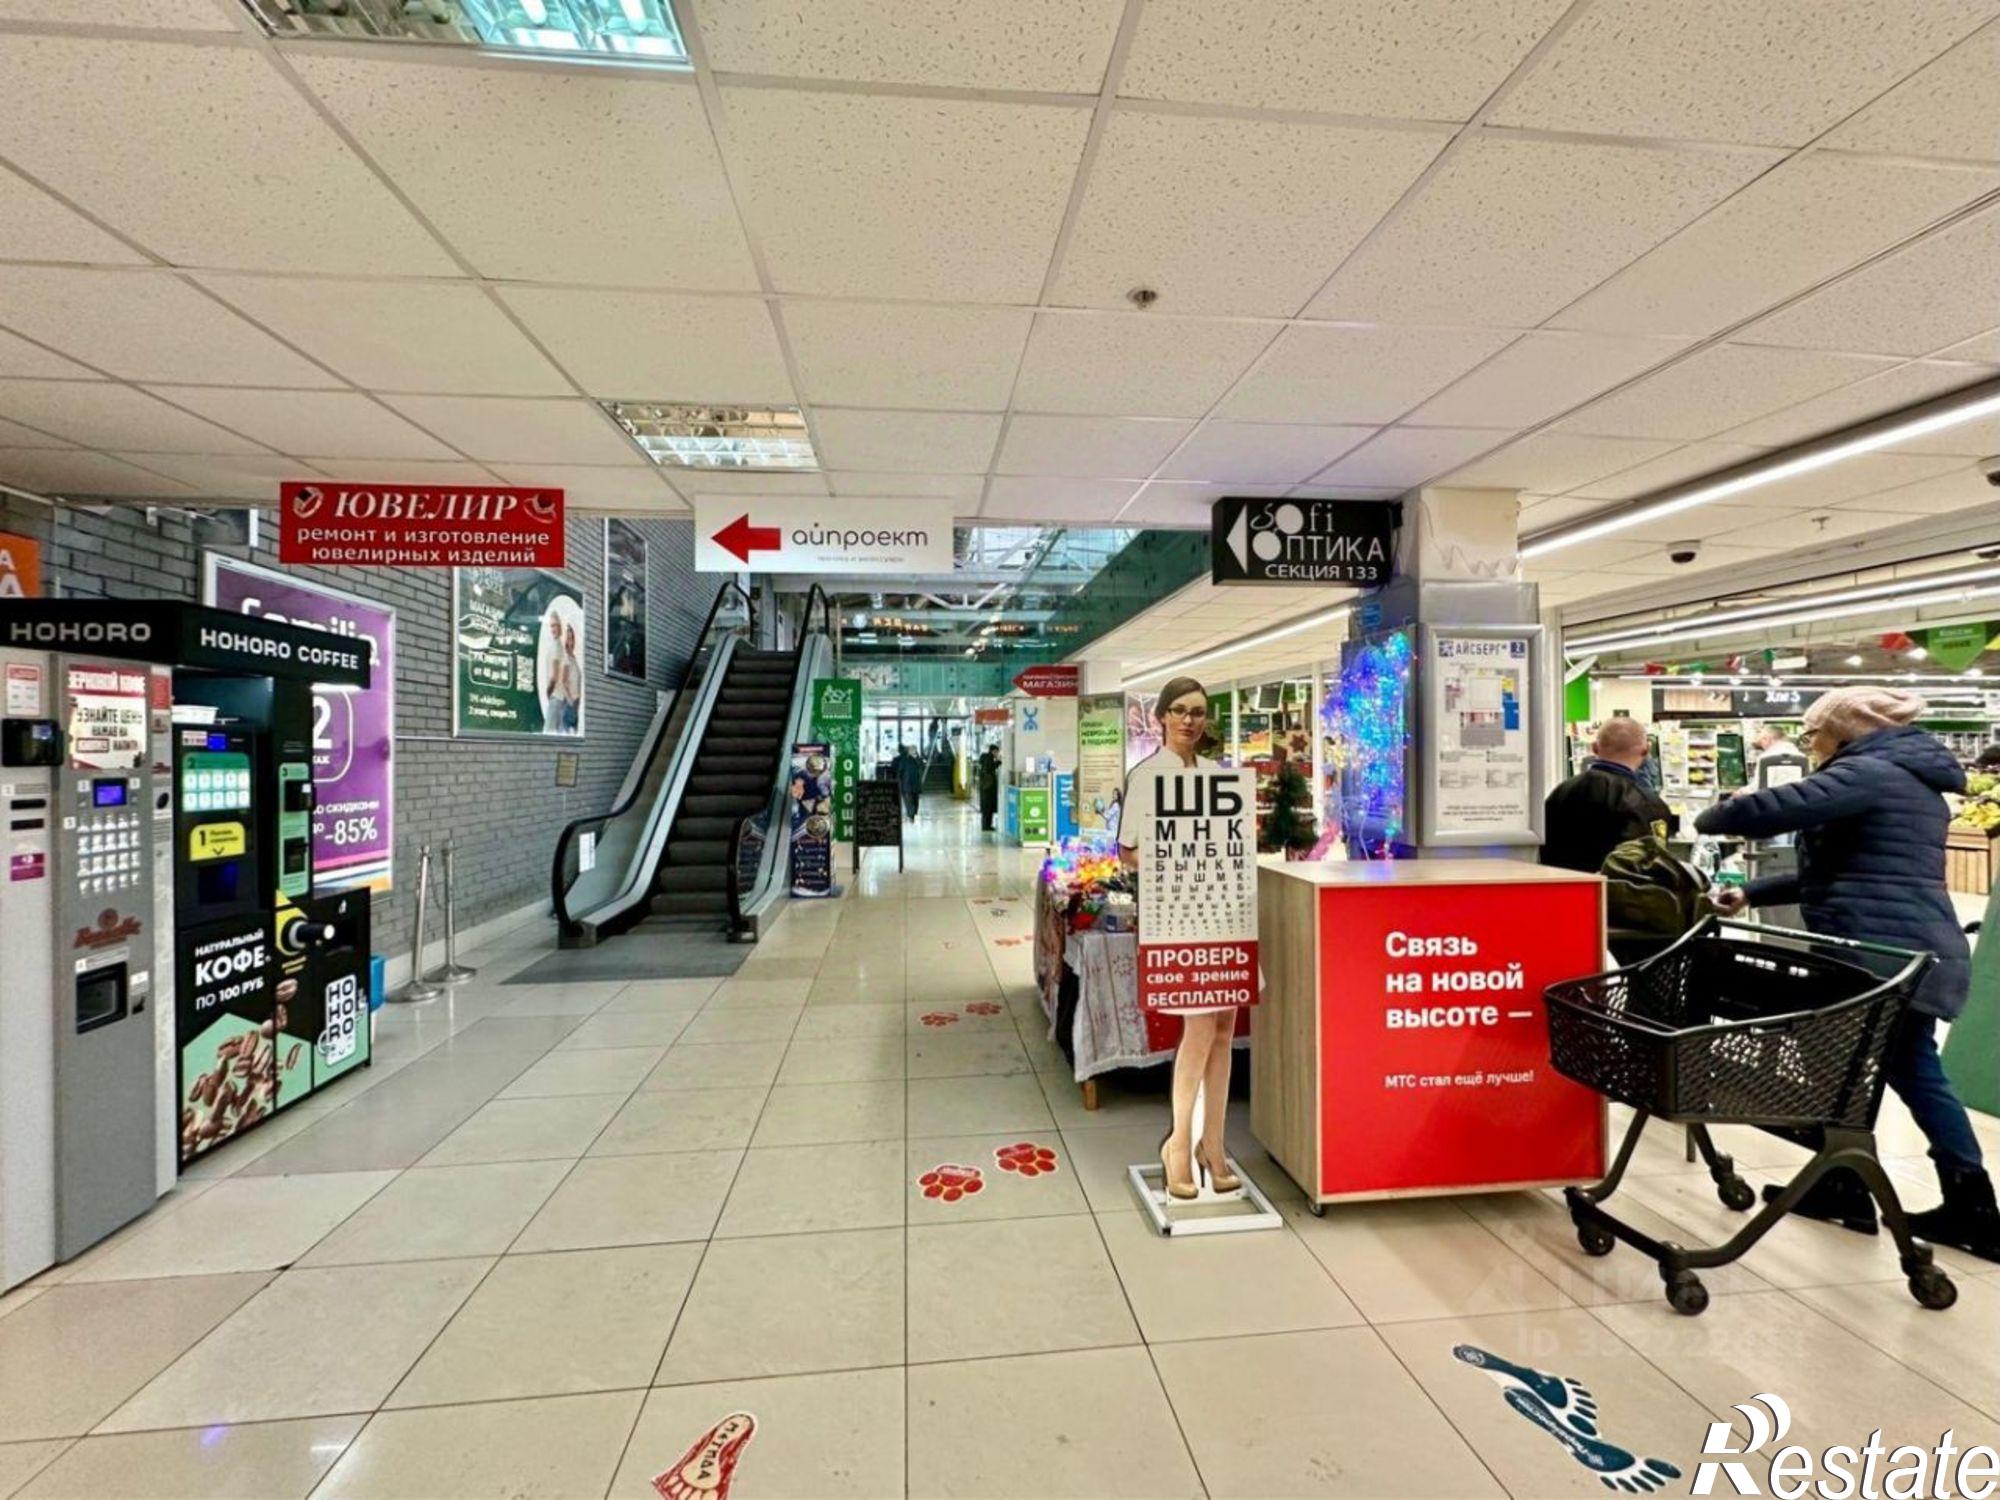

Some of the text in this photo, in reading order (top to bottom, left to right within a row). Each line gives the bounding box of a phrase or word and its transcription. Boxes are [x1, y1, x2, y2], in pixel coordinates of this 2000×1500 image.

[334, 490, 518, 521] ЮВЕЛИР
[298, 527, 550, 545] ремонт и изготовление
[792, 523, 928, 550] айпроект
[312, 546, 537, 564] ювелирных изделий
[1265, 563, 1378, 580] СЕКЦИЯ 133
[11, 622, 152, 642] HOHORO
[201, 628, 359, 669] HOHORO COFFEE
[1455, 641, 1500, 656] АЙСБЕРГ
[313, 695, 333, 750] 2
[324, 815, 378, 845] -85%
[195, 927, 265, 957] НАТУРАЛЬНЫЙ
[1385, 931, 1478, 957] Связь
[195, 944, 266, 987] КОФЕ
[1146, 946, 1250, 968] ПРОВЕРЬ
[1146, 968, 1250, 985] свое зрение
[1386, 962, 1524, 993] на новой
[195, 976, 265, 1011] ПО 100 РУБ
[1146, 988, 1251, 1007] БЕСПЛАТНО
[1386, 1005, 1499, 1029] высоте
[1384, 1069, 1535, 1088] МТС стал ещё лучше!
